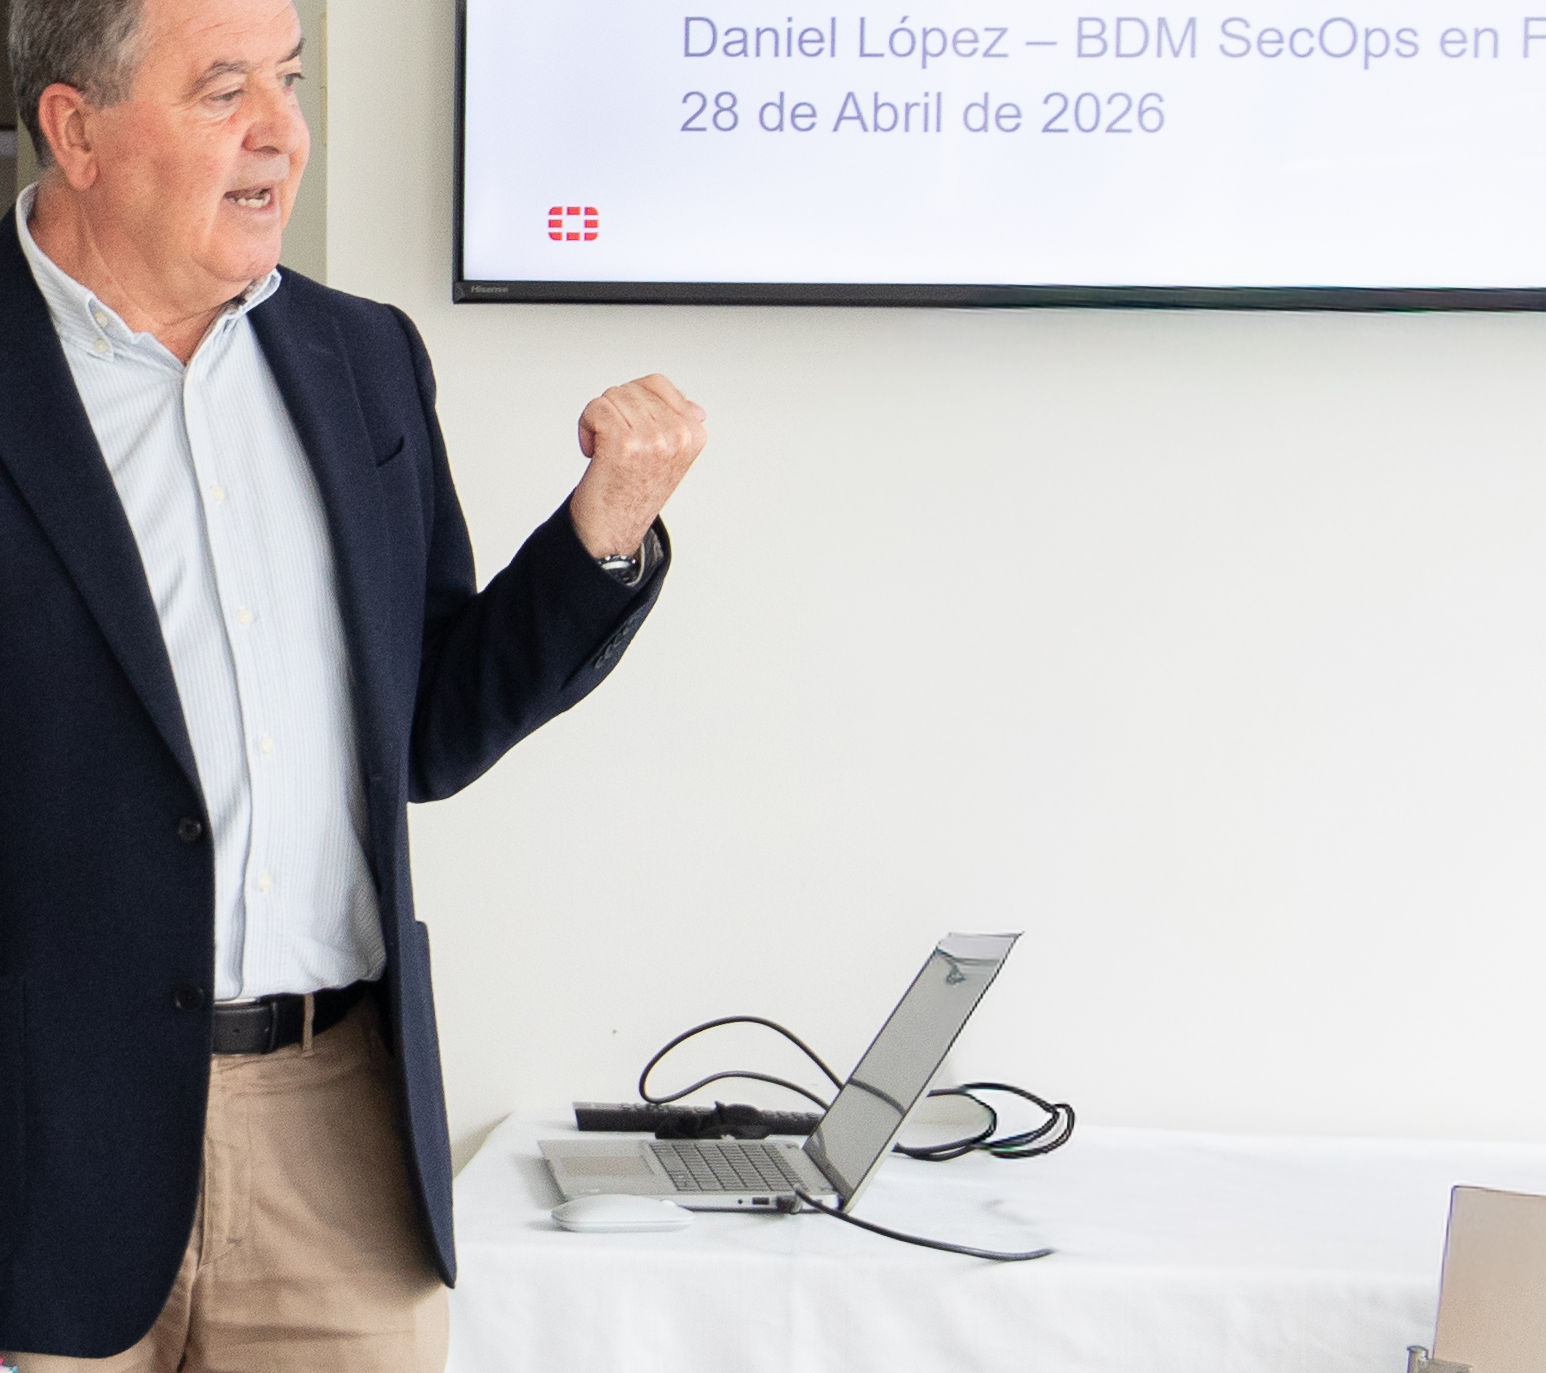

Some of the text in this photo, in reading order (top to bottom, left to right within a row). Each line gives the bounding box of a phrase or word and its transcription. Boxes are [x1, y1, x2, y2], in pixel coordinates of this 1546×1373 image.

[680, 15, 839, 60] Daniel
[858, 14, 1010, 70] López
[1075, 15, 1198, 60] BDM
[1218, 14, 1421, 70] SecOps
[1439, 26, 1502, 60] en
[679, 89, 1167, 134] 28 de Abril de 2026
